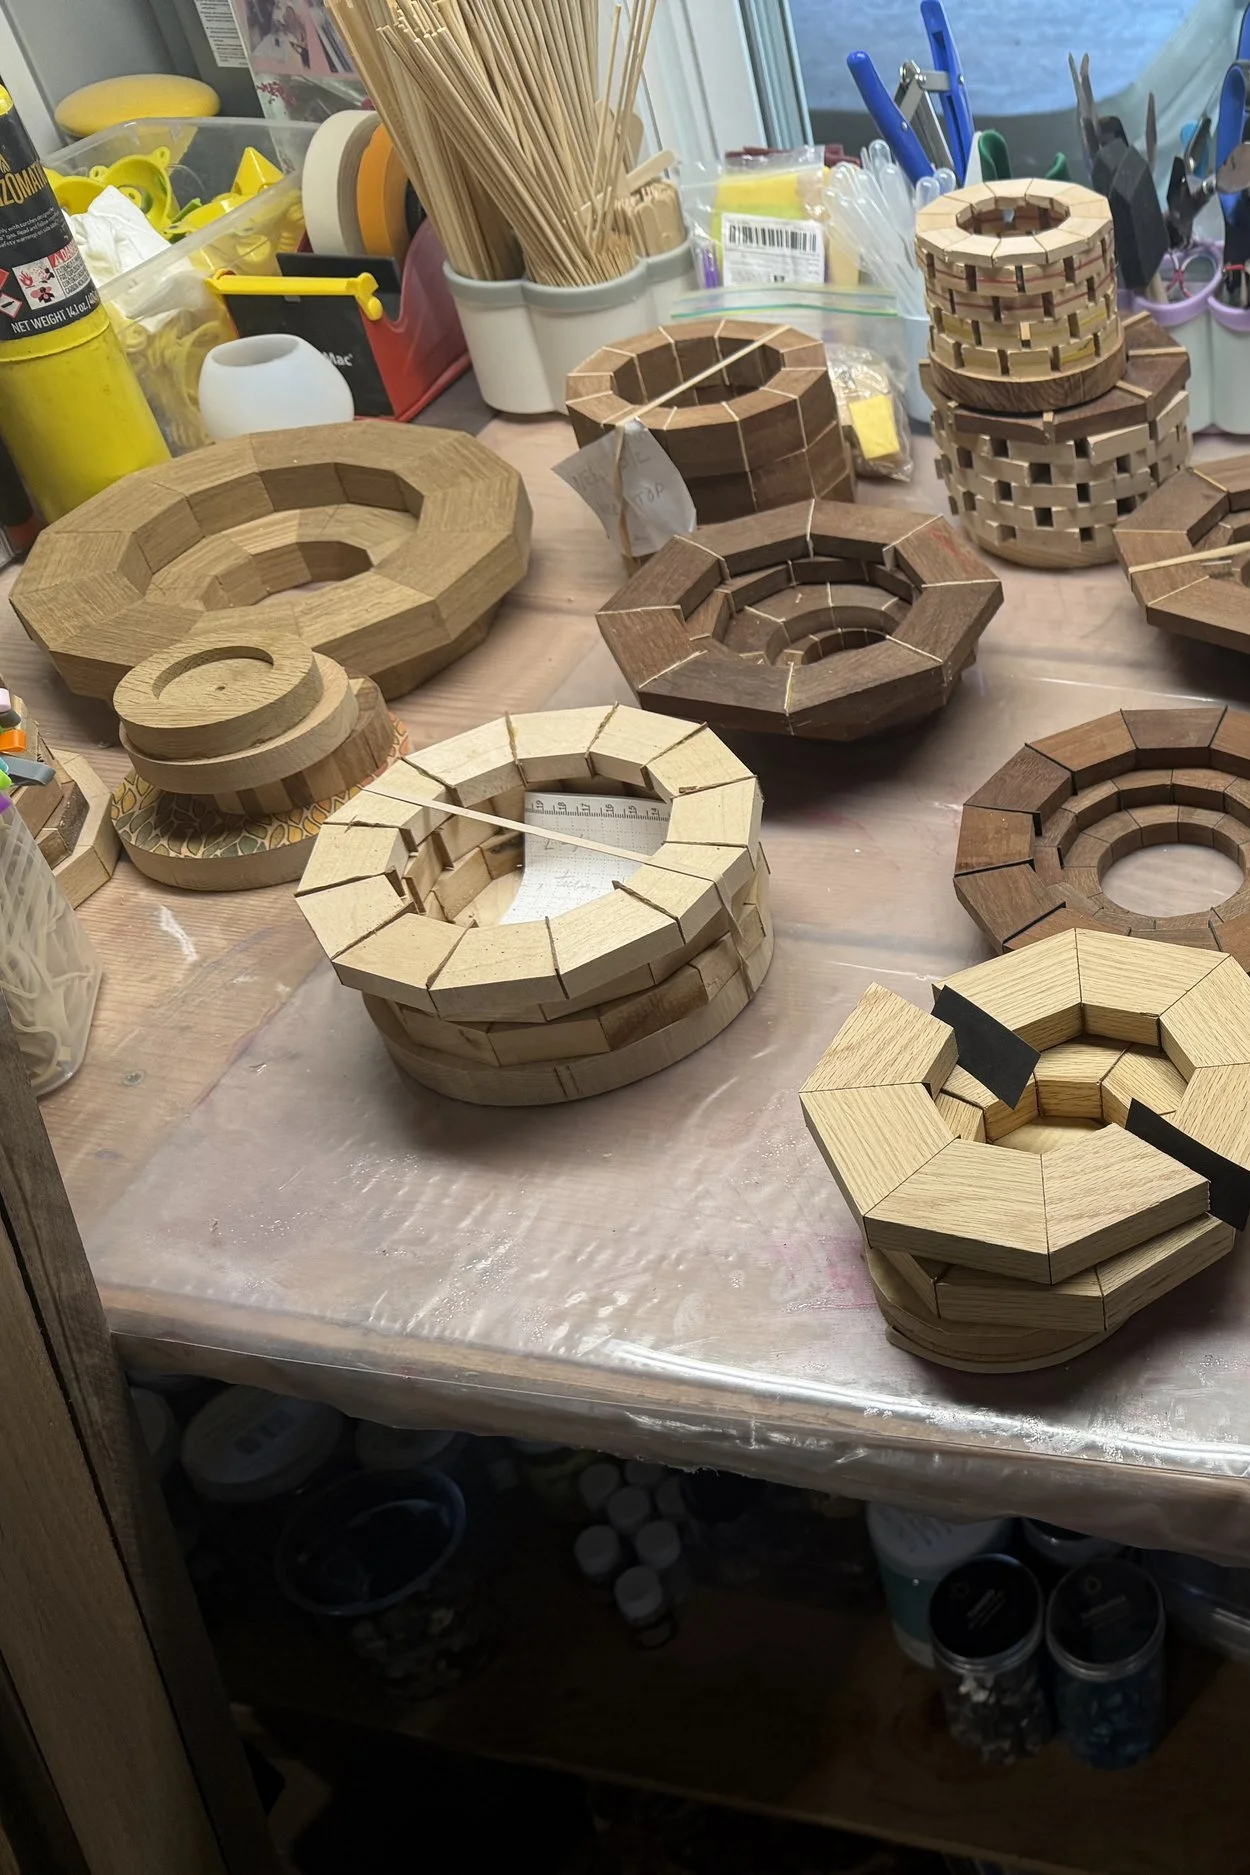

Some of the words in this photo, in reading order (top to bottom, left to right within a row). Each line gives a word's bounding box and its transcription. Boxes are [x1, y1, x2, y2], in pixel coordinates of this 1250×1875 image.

[11, 320, 32, 334] NET
[30, 309, 67, 330] WEIGHT
[536, 800, 544, 812] 19
[558, 801, 567, 812] 18
[581, 803, 591, 812] 17
[605, 803, 614, 813] 16
[628, 805, 638, 814] 15
[651, 807, 660, 815] 14
